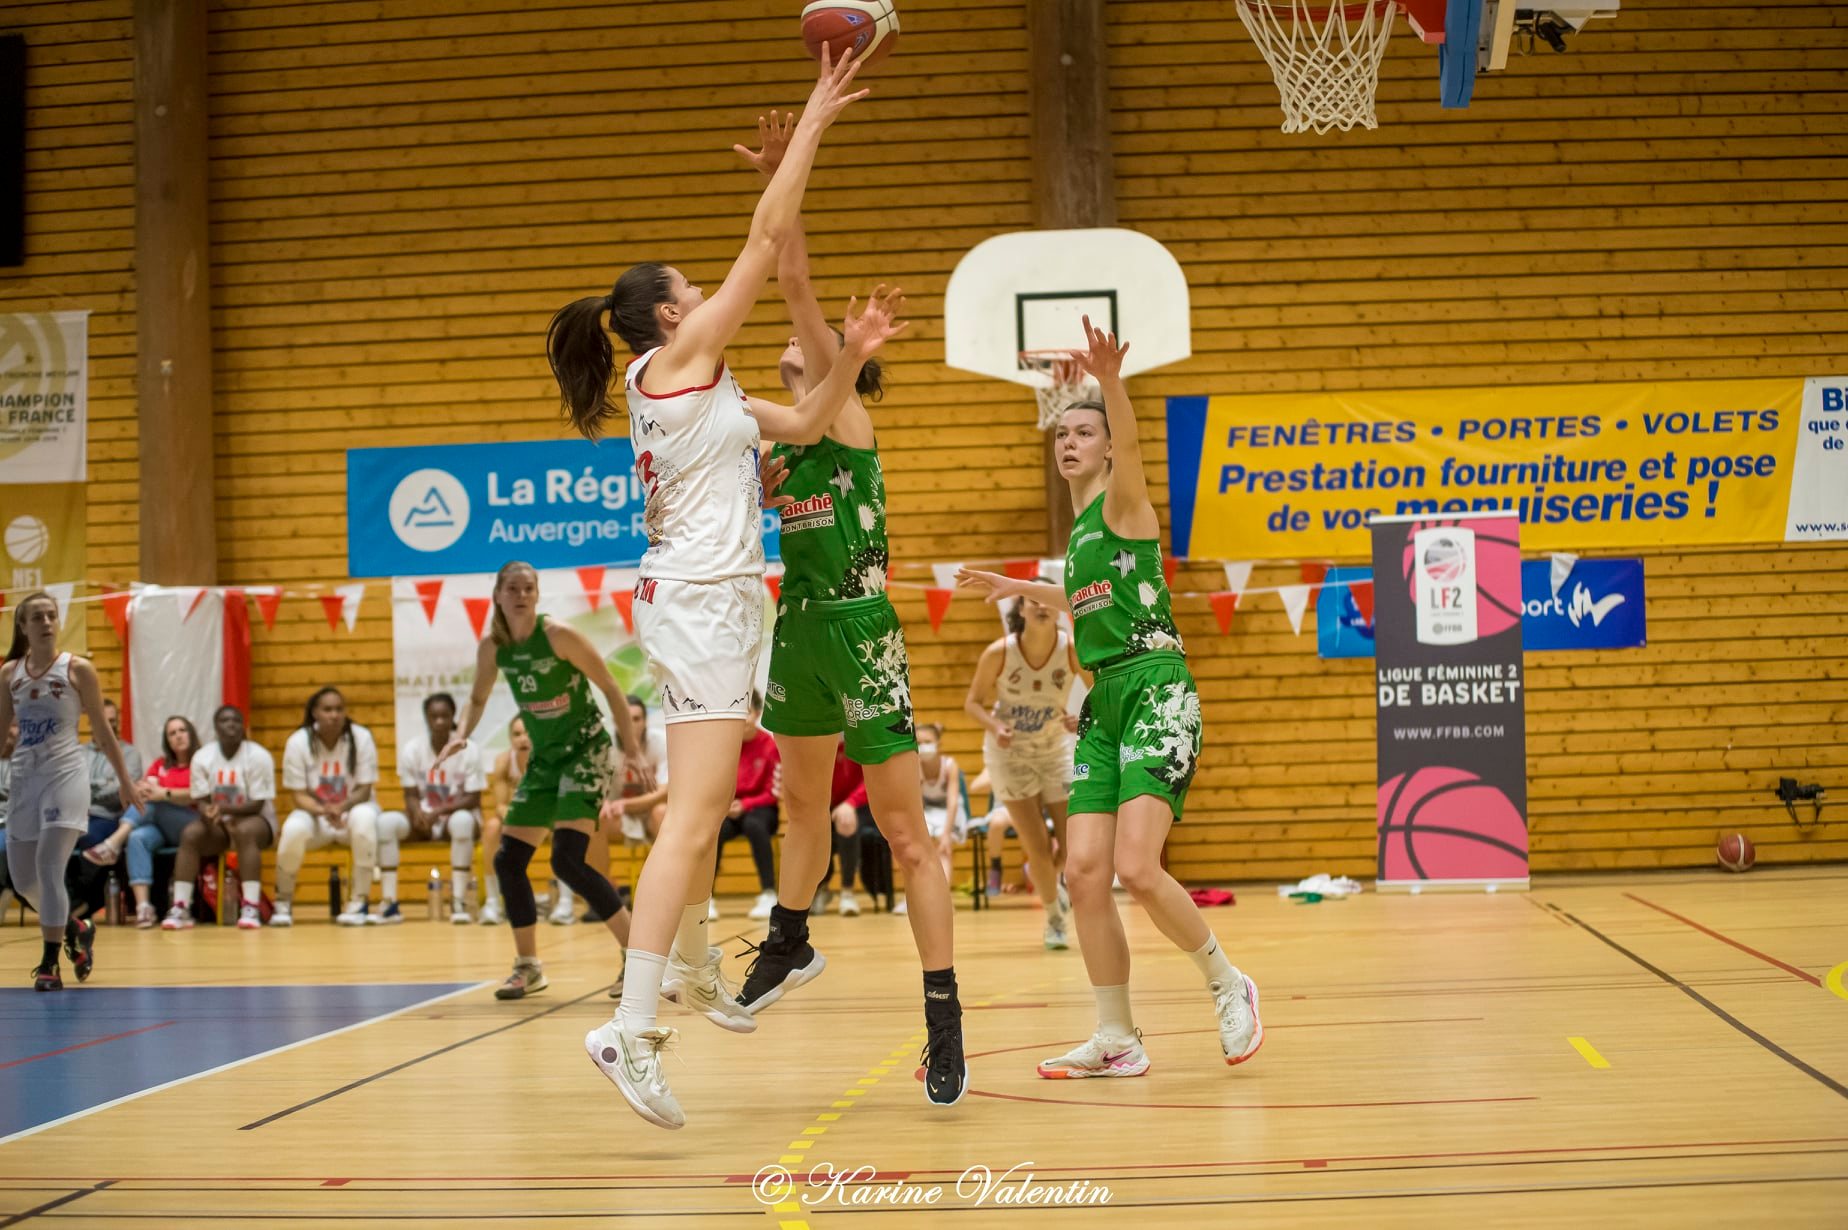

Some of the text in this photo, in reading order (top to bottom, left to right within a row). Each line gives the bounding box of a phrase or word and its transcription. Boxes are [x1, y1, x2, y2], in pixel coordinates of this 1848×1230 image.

[8, 409, 75, 424] FRANCE
[1227, 408, 1780, 448] FENÊTRES PORTES VOLETS
[1808, 419, 1840, 434] que
[1823, 436, 1844, 450] de
[1218, 452, 1777, 494] Prestation fourniture et pose
[487, 471, 535, 506] La
[784, 493, 832, 516] arché
[1267, 504, 1311, 532] de
[1321, 507, 1382, 530] vos
[1430, 586, 1462, 609] LF2
[517, 674, 537, 693] 29
[1379, 664, 1517, 683] LIGUE FÉMININE 2
[1379, 680, 1520, 707] DE BASKET
[1394, 726, 1504, 740] WWW.FFBB.COM
